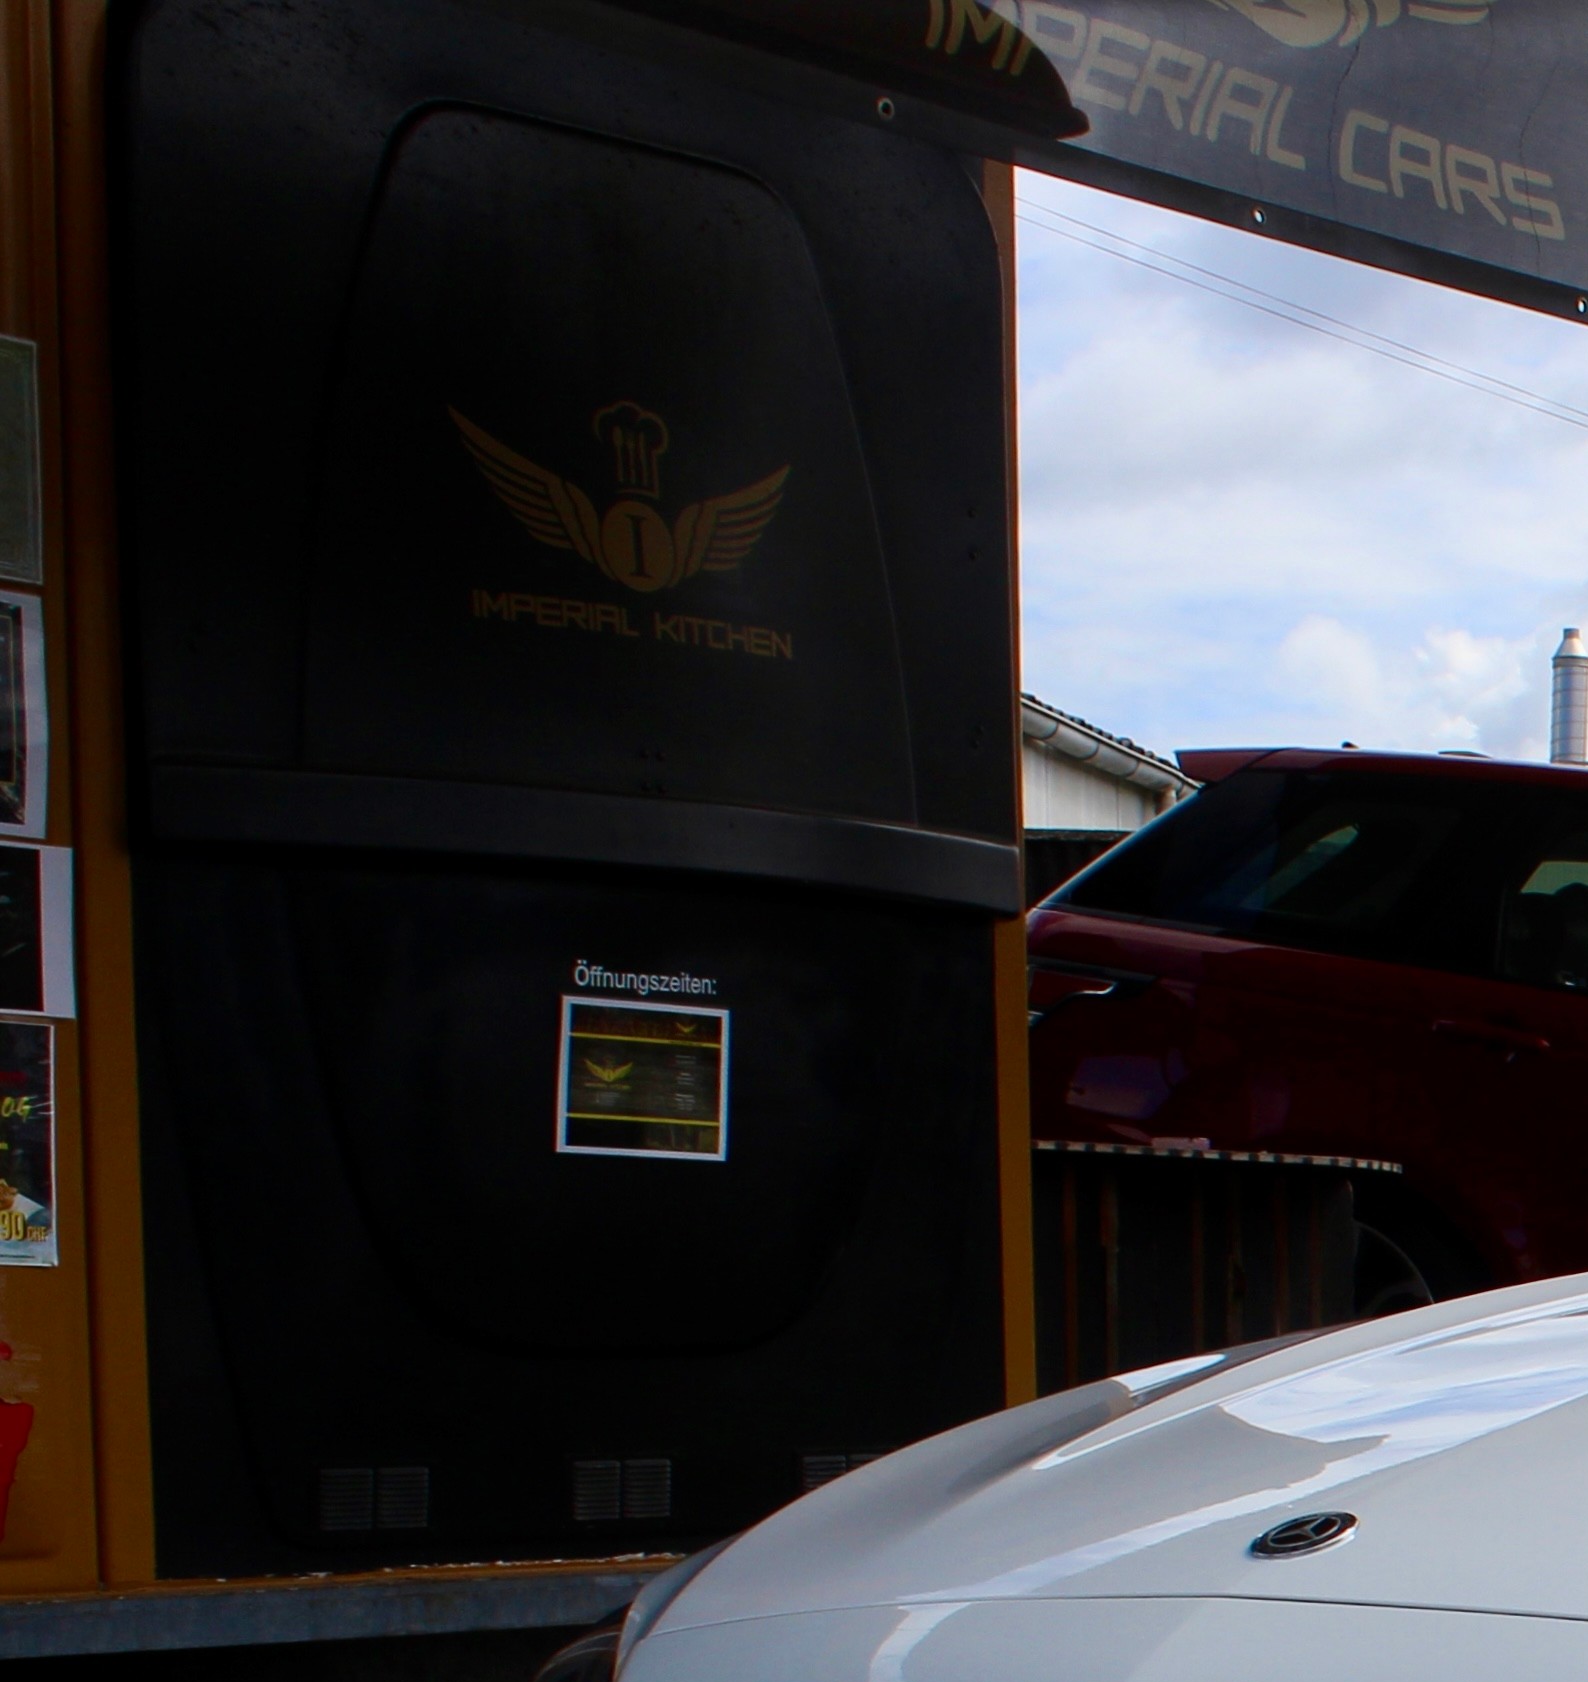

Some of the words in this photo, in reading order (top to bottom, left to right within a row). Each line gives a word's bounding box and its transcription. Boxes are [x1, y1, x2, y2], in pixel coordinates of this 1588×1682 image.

[924, 0, 1305, 169] IMPERIAL
[1339, 109, 1565, 241] CARS
[471, 588, 640, 638] IMPERIAL
[653, 611, 793, 660] KITCHEN
[574, 959, 718, 995] Öffnungszeiten:
